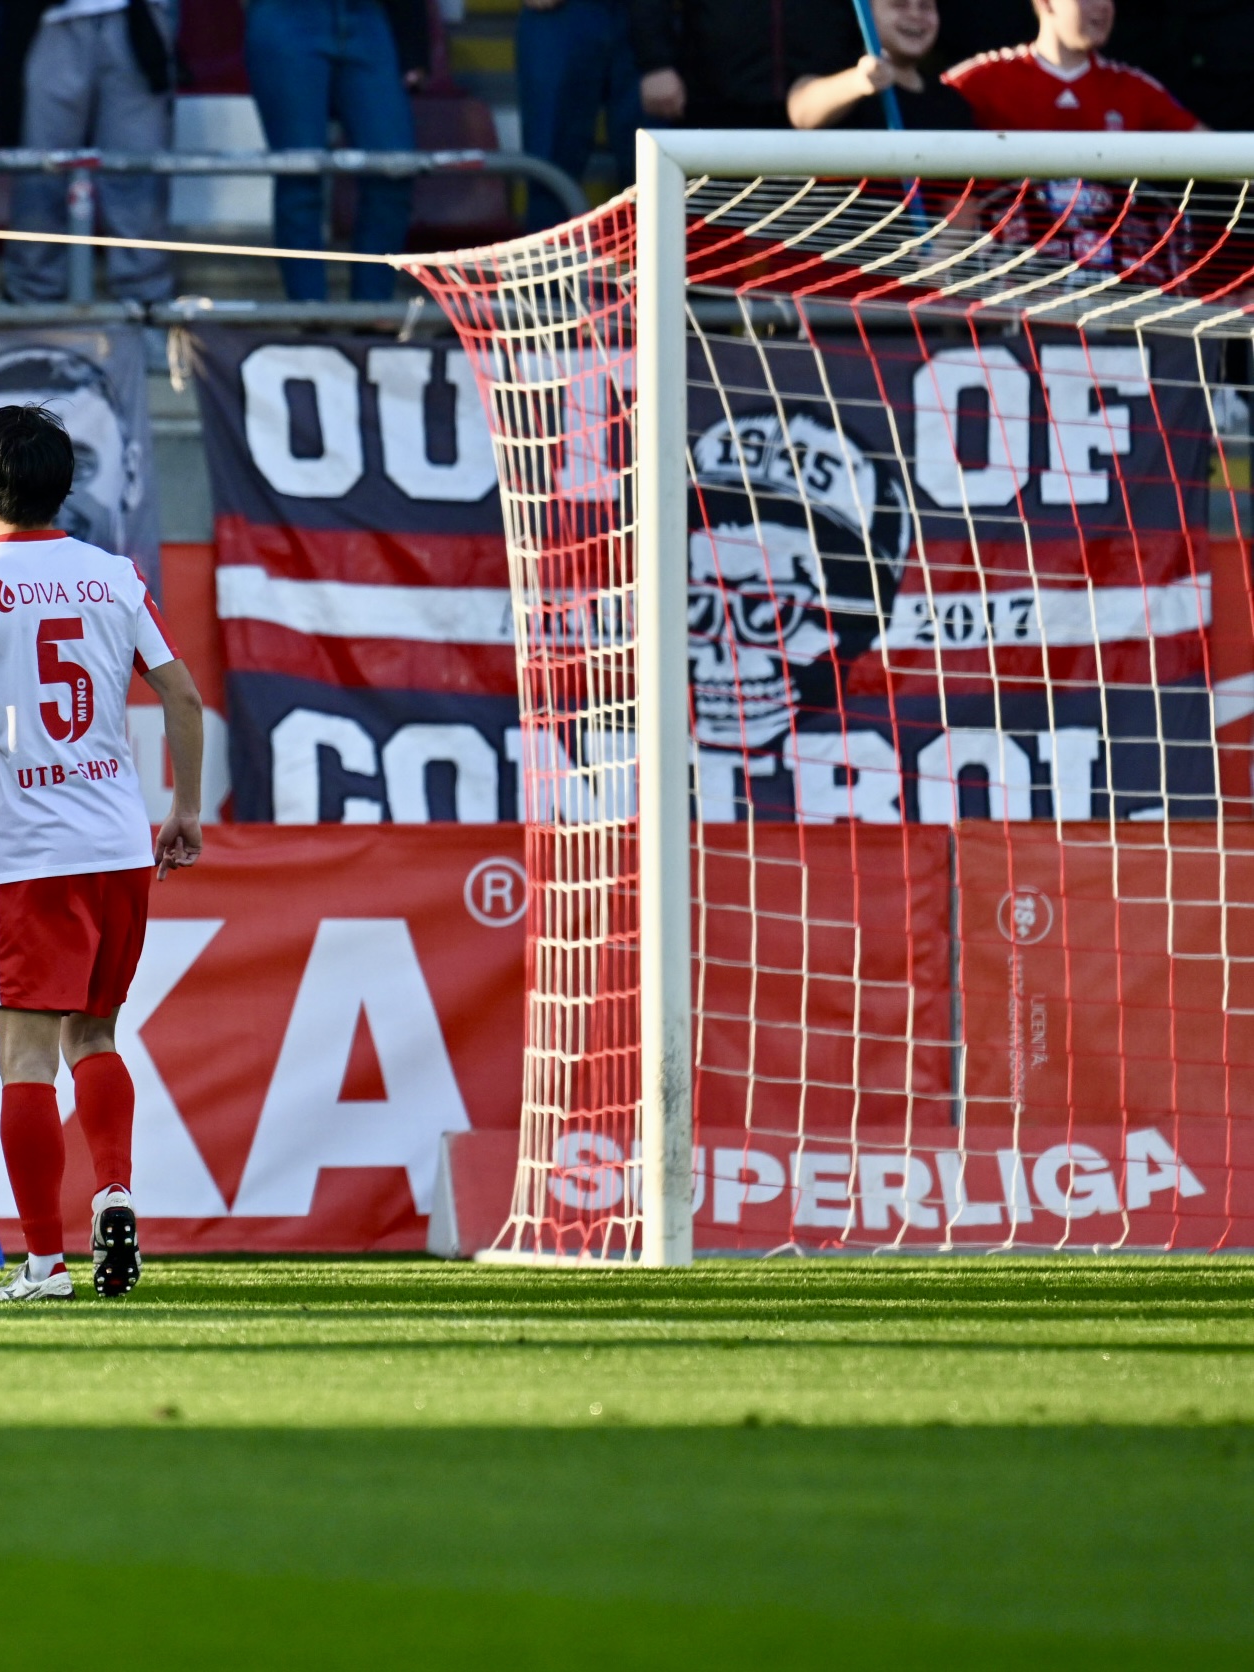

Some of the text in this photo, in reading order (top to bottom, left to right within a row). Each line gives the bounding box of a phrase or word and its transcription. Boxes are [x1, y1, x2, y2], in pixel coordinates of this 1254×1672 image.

[240, 343, 1153, 508] OUT OF
[17, 580, 115, 605] DIVA SOL
[912, 599, 1036, 642] 2017
[36, 617, 94, 743] 5
[77, 677, 87, 722] MINO
[17, 758, 119, 789] UTB-SHOP
[545, 1127, 1206, 1230] SPERLIGA
